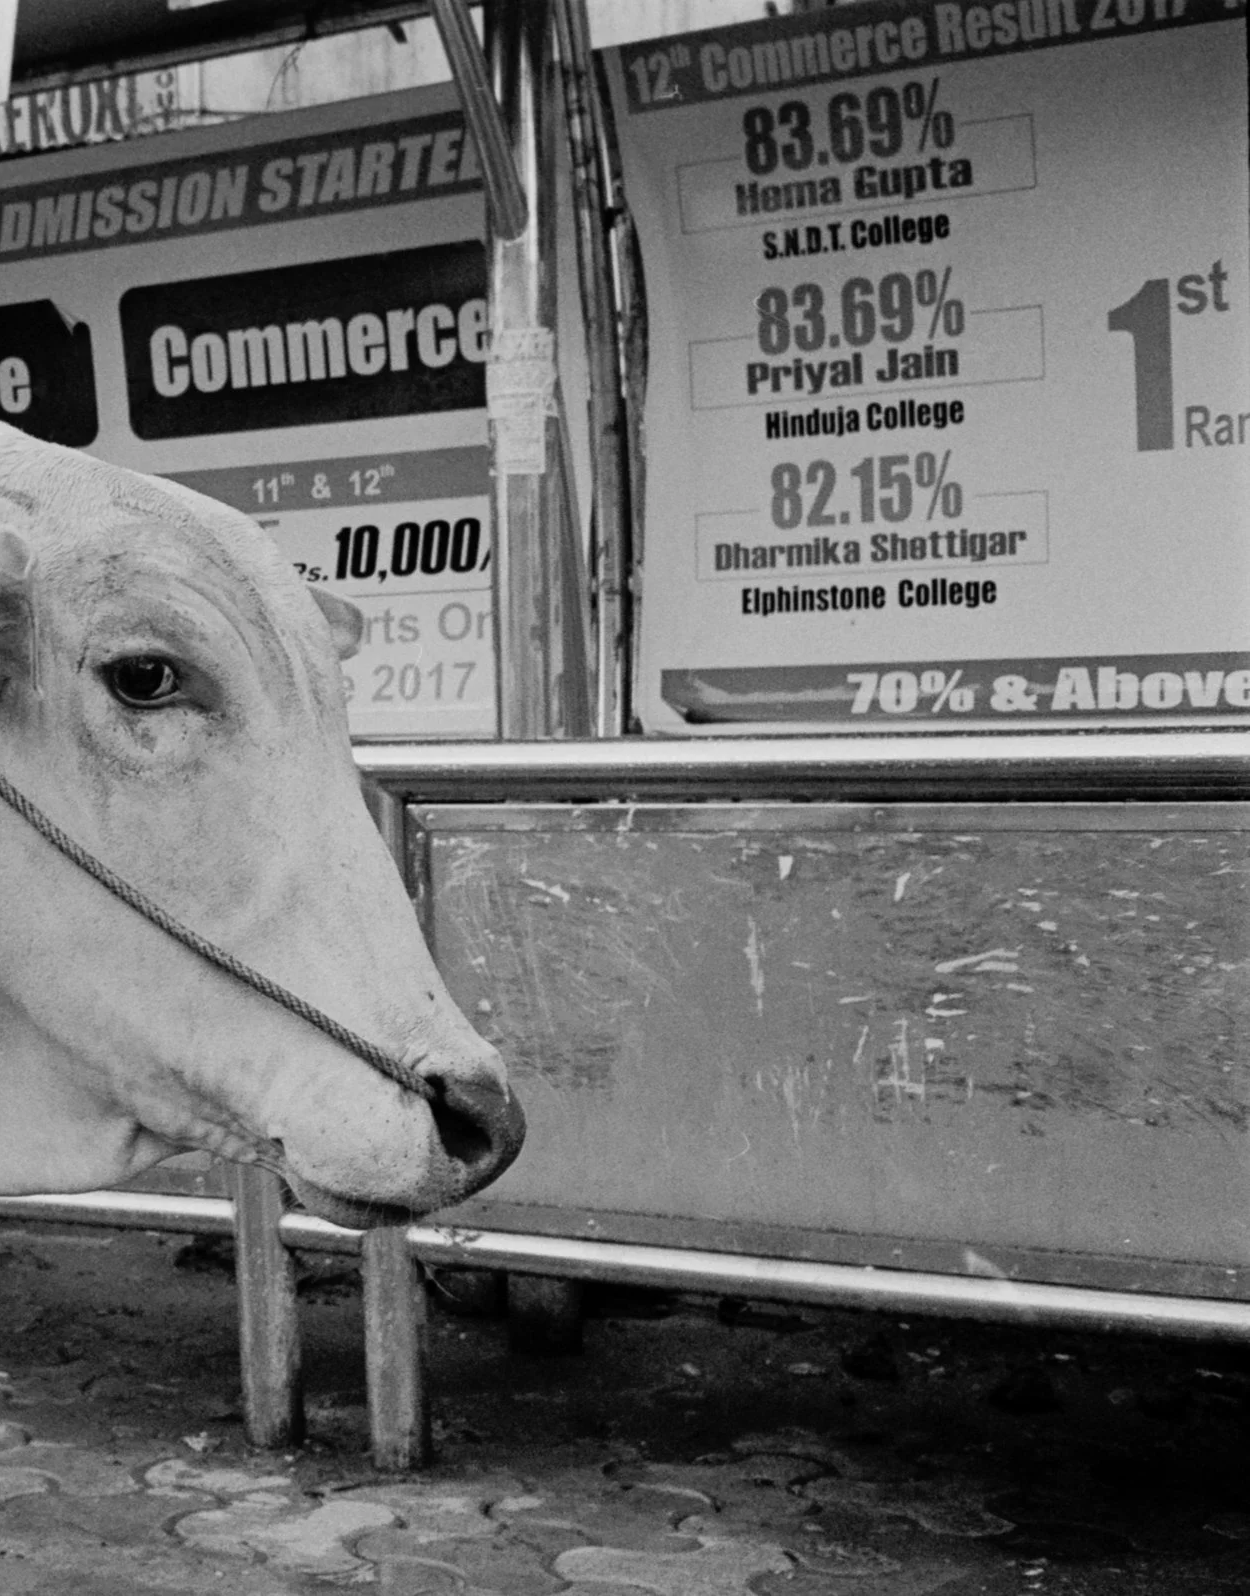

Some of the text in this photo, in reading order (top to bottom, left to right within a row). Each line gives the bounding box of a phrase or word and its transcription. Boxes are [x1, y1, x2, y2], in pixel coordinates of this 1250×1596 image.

[630, 45, 691, 101] 12th
[702, 26, 927, 94] Commerce
[934, 0, 1081, 54] Result
[743, 77, 955, 177] 83.69%
[735, 155, 973, 217] Hema Gupta
[762, 212, 951, 261] S.N.D.T. College
[758, 266, 966, 357] 83.69%
[150, 299, 488, 398] Commerce
[746, 346, 960, 396] Priyal Jain
[765, 399, 966, 441] Hinduja College
[252, 464, 396, 504] 11th & 12th
[770, 449, 964, 530] 82.15%
[714, 528, 1027, 573] Dharmika Shettigar
[741, 576, 998, 617] Elphinstone College
[365, 607, 420, 645] rts
[371, 661, 477, 704] 2017
[846, 664, 1250, 716] 70% & Above
